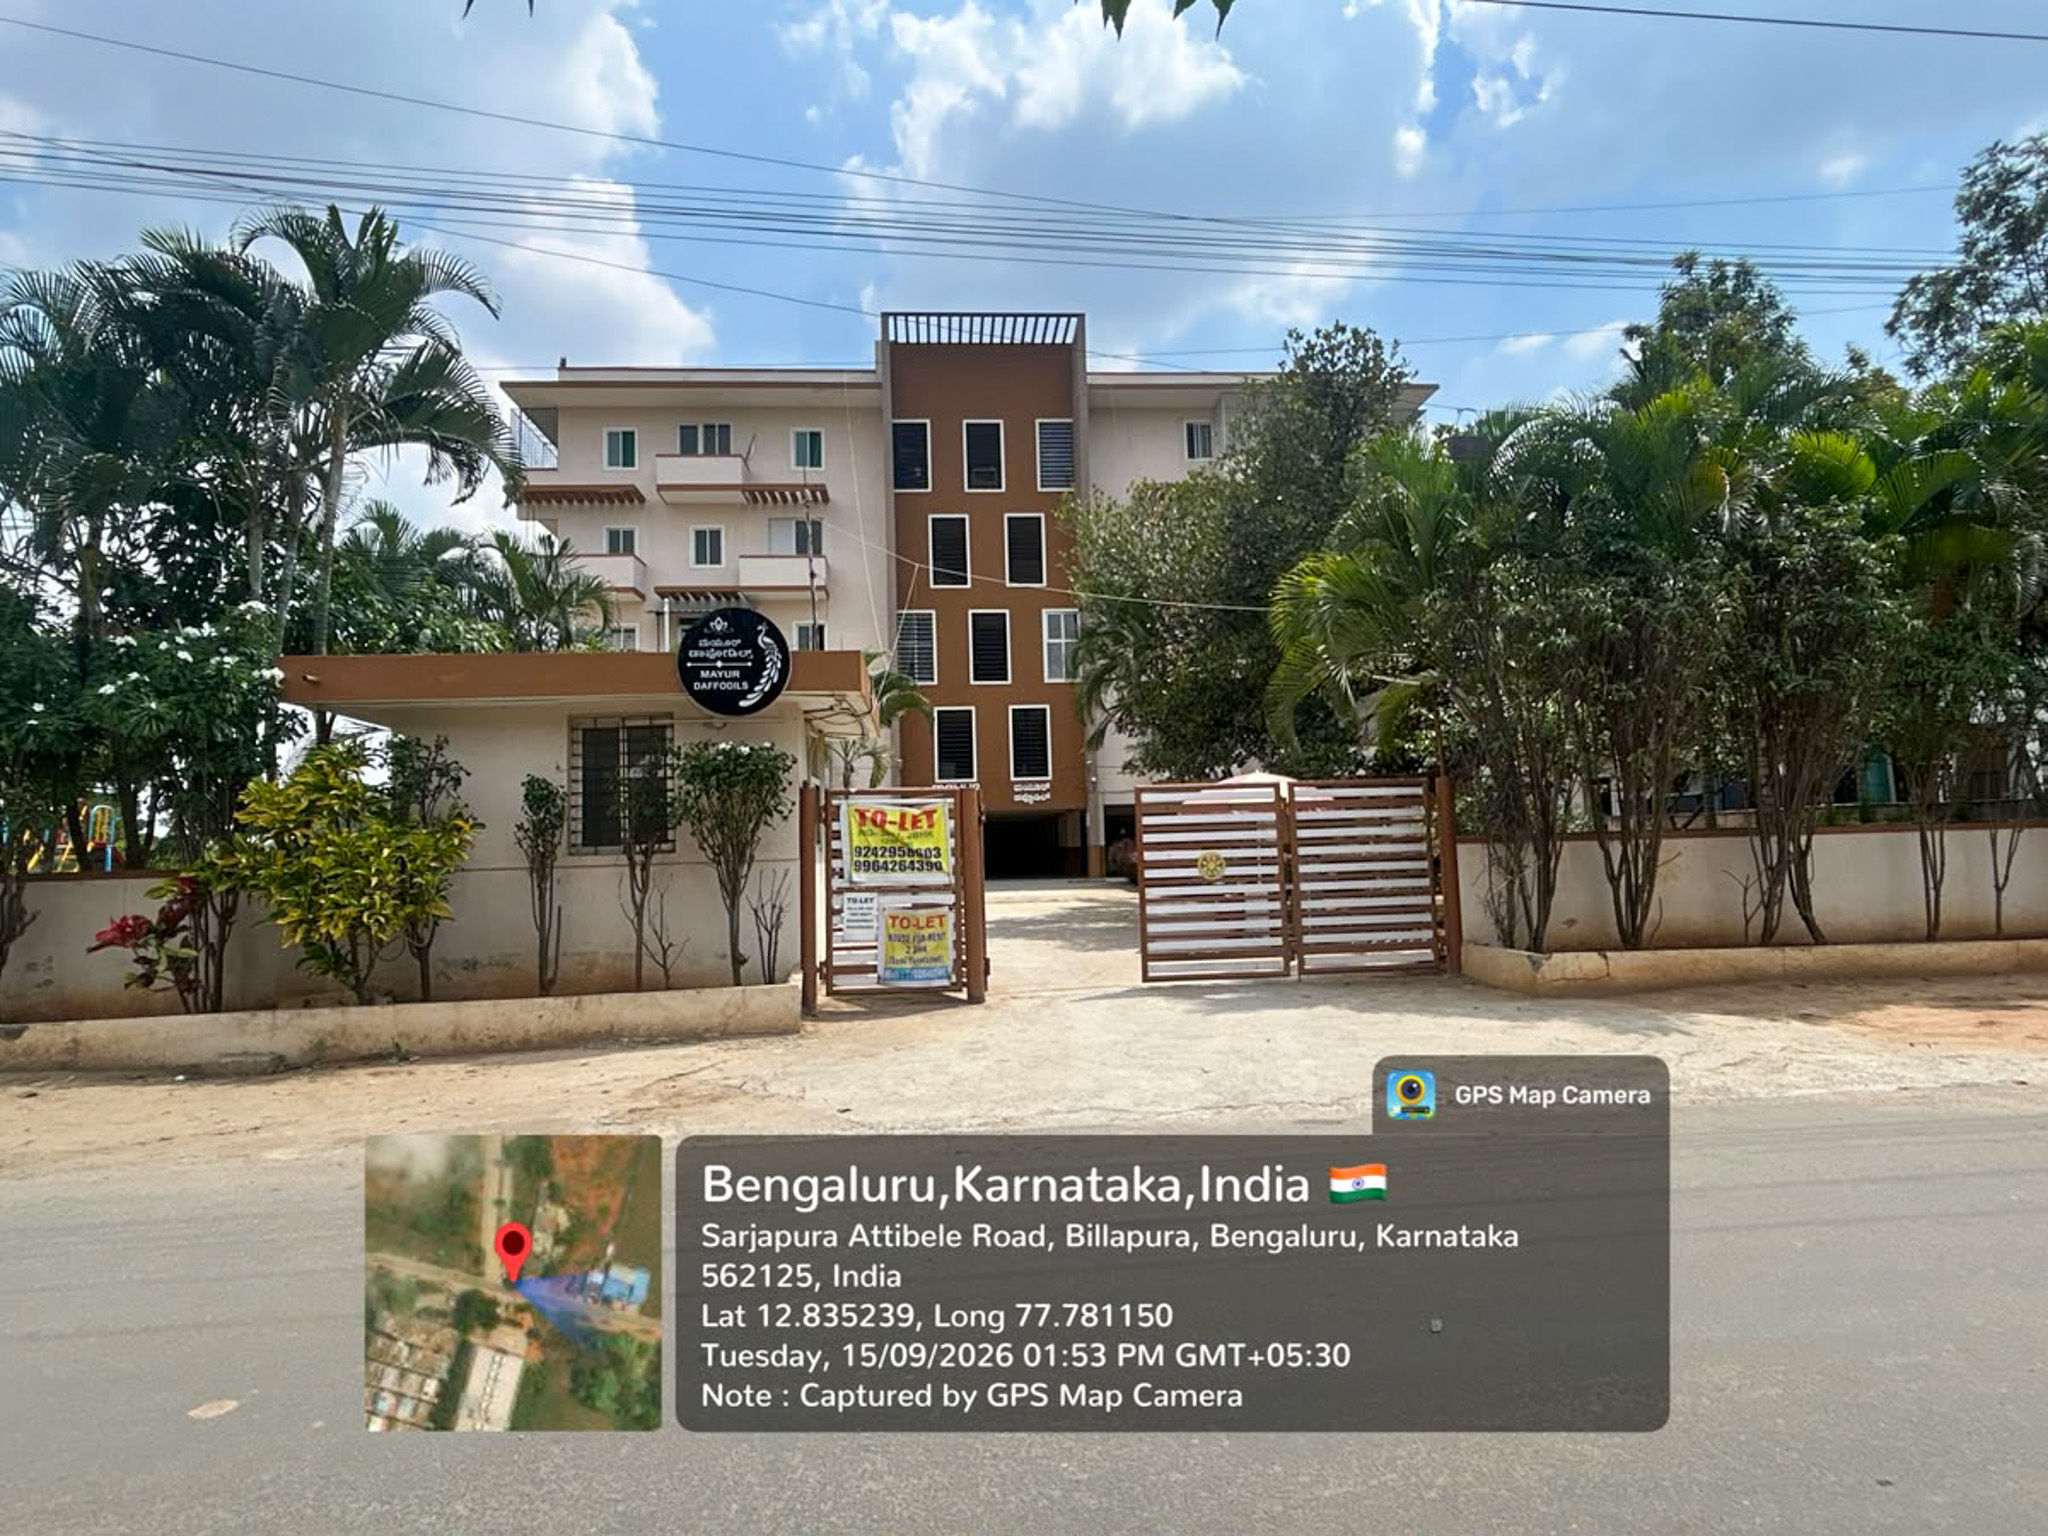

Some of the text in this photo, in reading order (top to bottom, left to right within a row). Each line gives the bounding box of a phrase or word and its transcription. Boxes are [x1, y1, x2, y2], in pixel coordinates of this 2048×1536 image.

[700, 669, 740, 679] MAYUR
[693, 681, 749, 691] DAFFODILS
[854, 808, 938, 831] TO-LET
